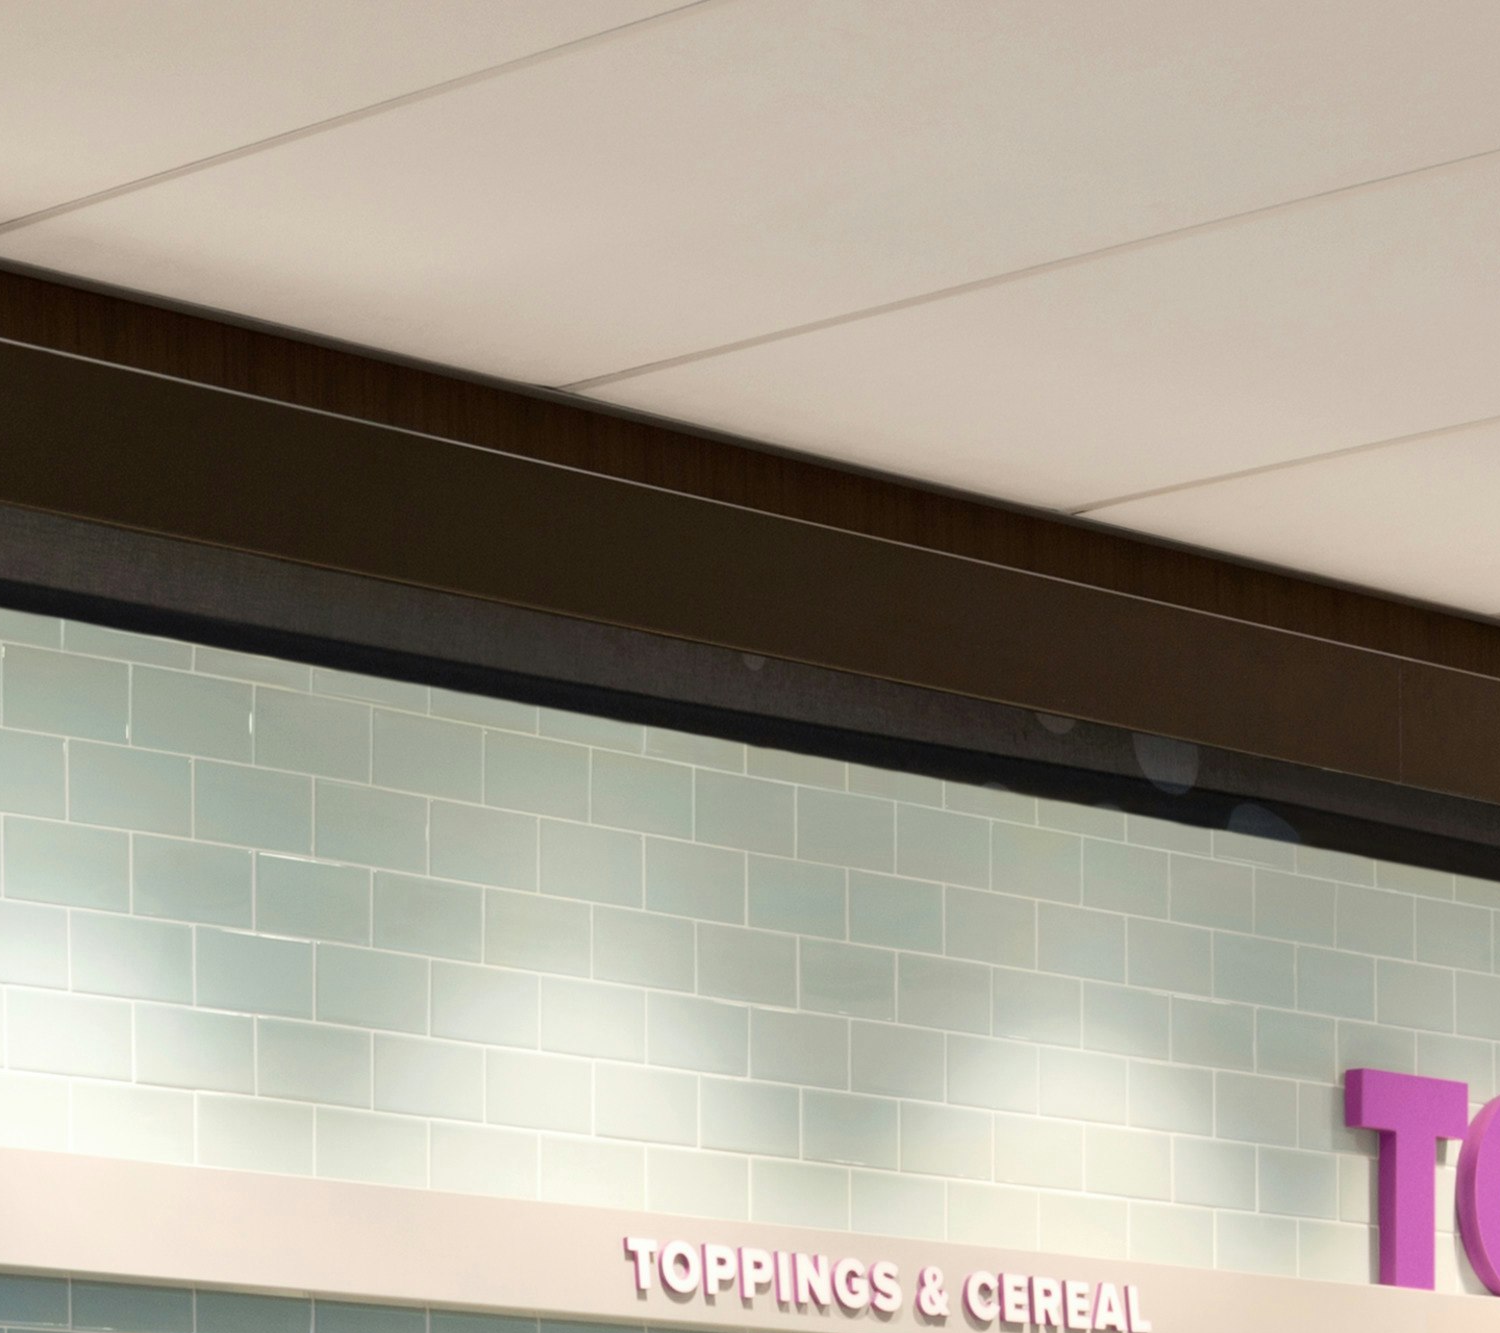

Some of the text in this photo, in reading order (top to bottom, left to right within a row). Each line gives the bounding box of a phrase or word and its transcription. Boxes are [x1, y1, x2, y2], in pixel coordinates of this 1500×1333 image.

[623, 1236, 1152, 1333] TOPPINGS & CEREAL
